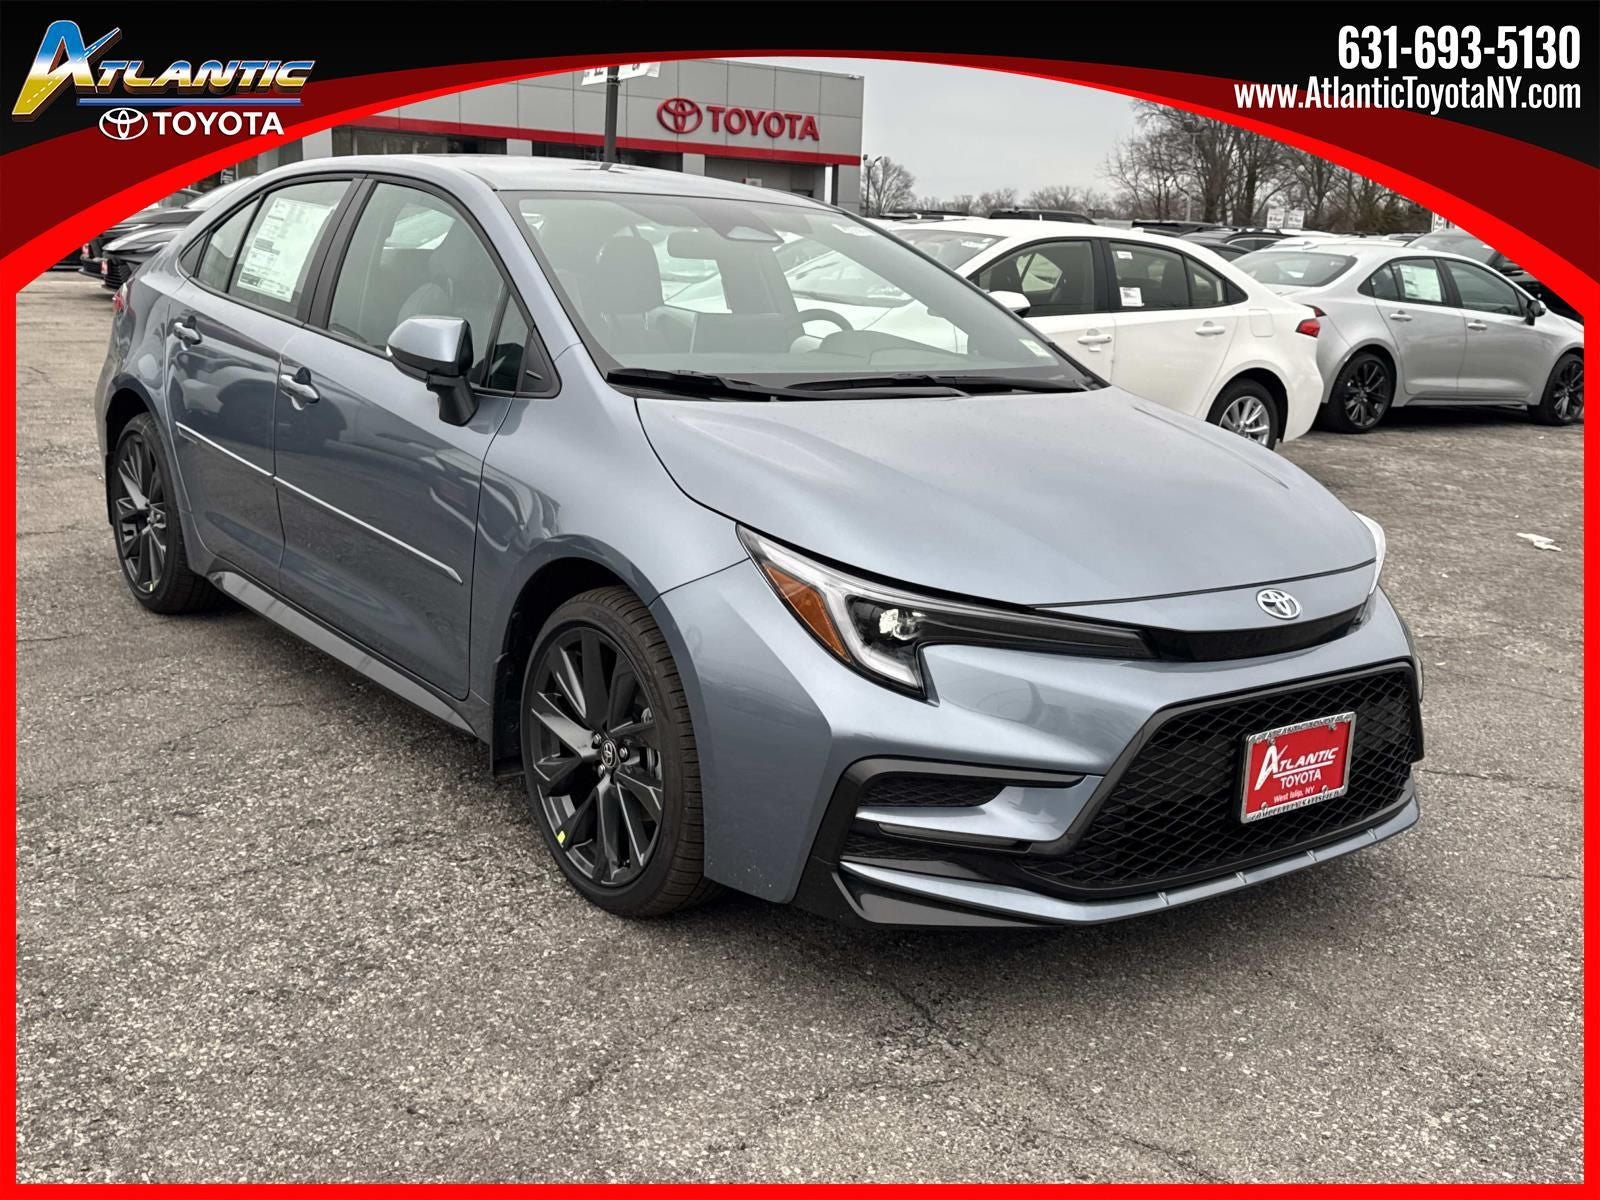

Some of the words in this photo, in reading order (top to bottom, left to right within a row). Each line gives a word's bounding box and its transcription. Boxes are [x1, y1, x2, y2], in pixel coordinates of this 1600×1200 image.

[706, 105, 820, 141] TOYOTA
[1254, 744, 1339, 791] ATLANTIC
[1280, 769, 1321, 789] TOYOTA
[1305, 786, 1315, 795] NY
